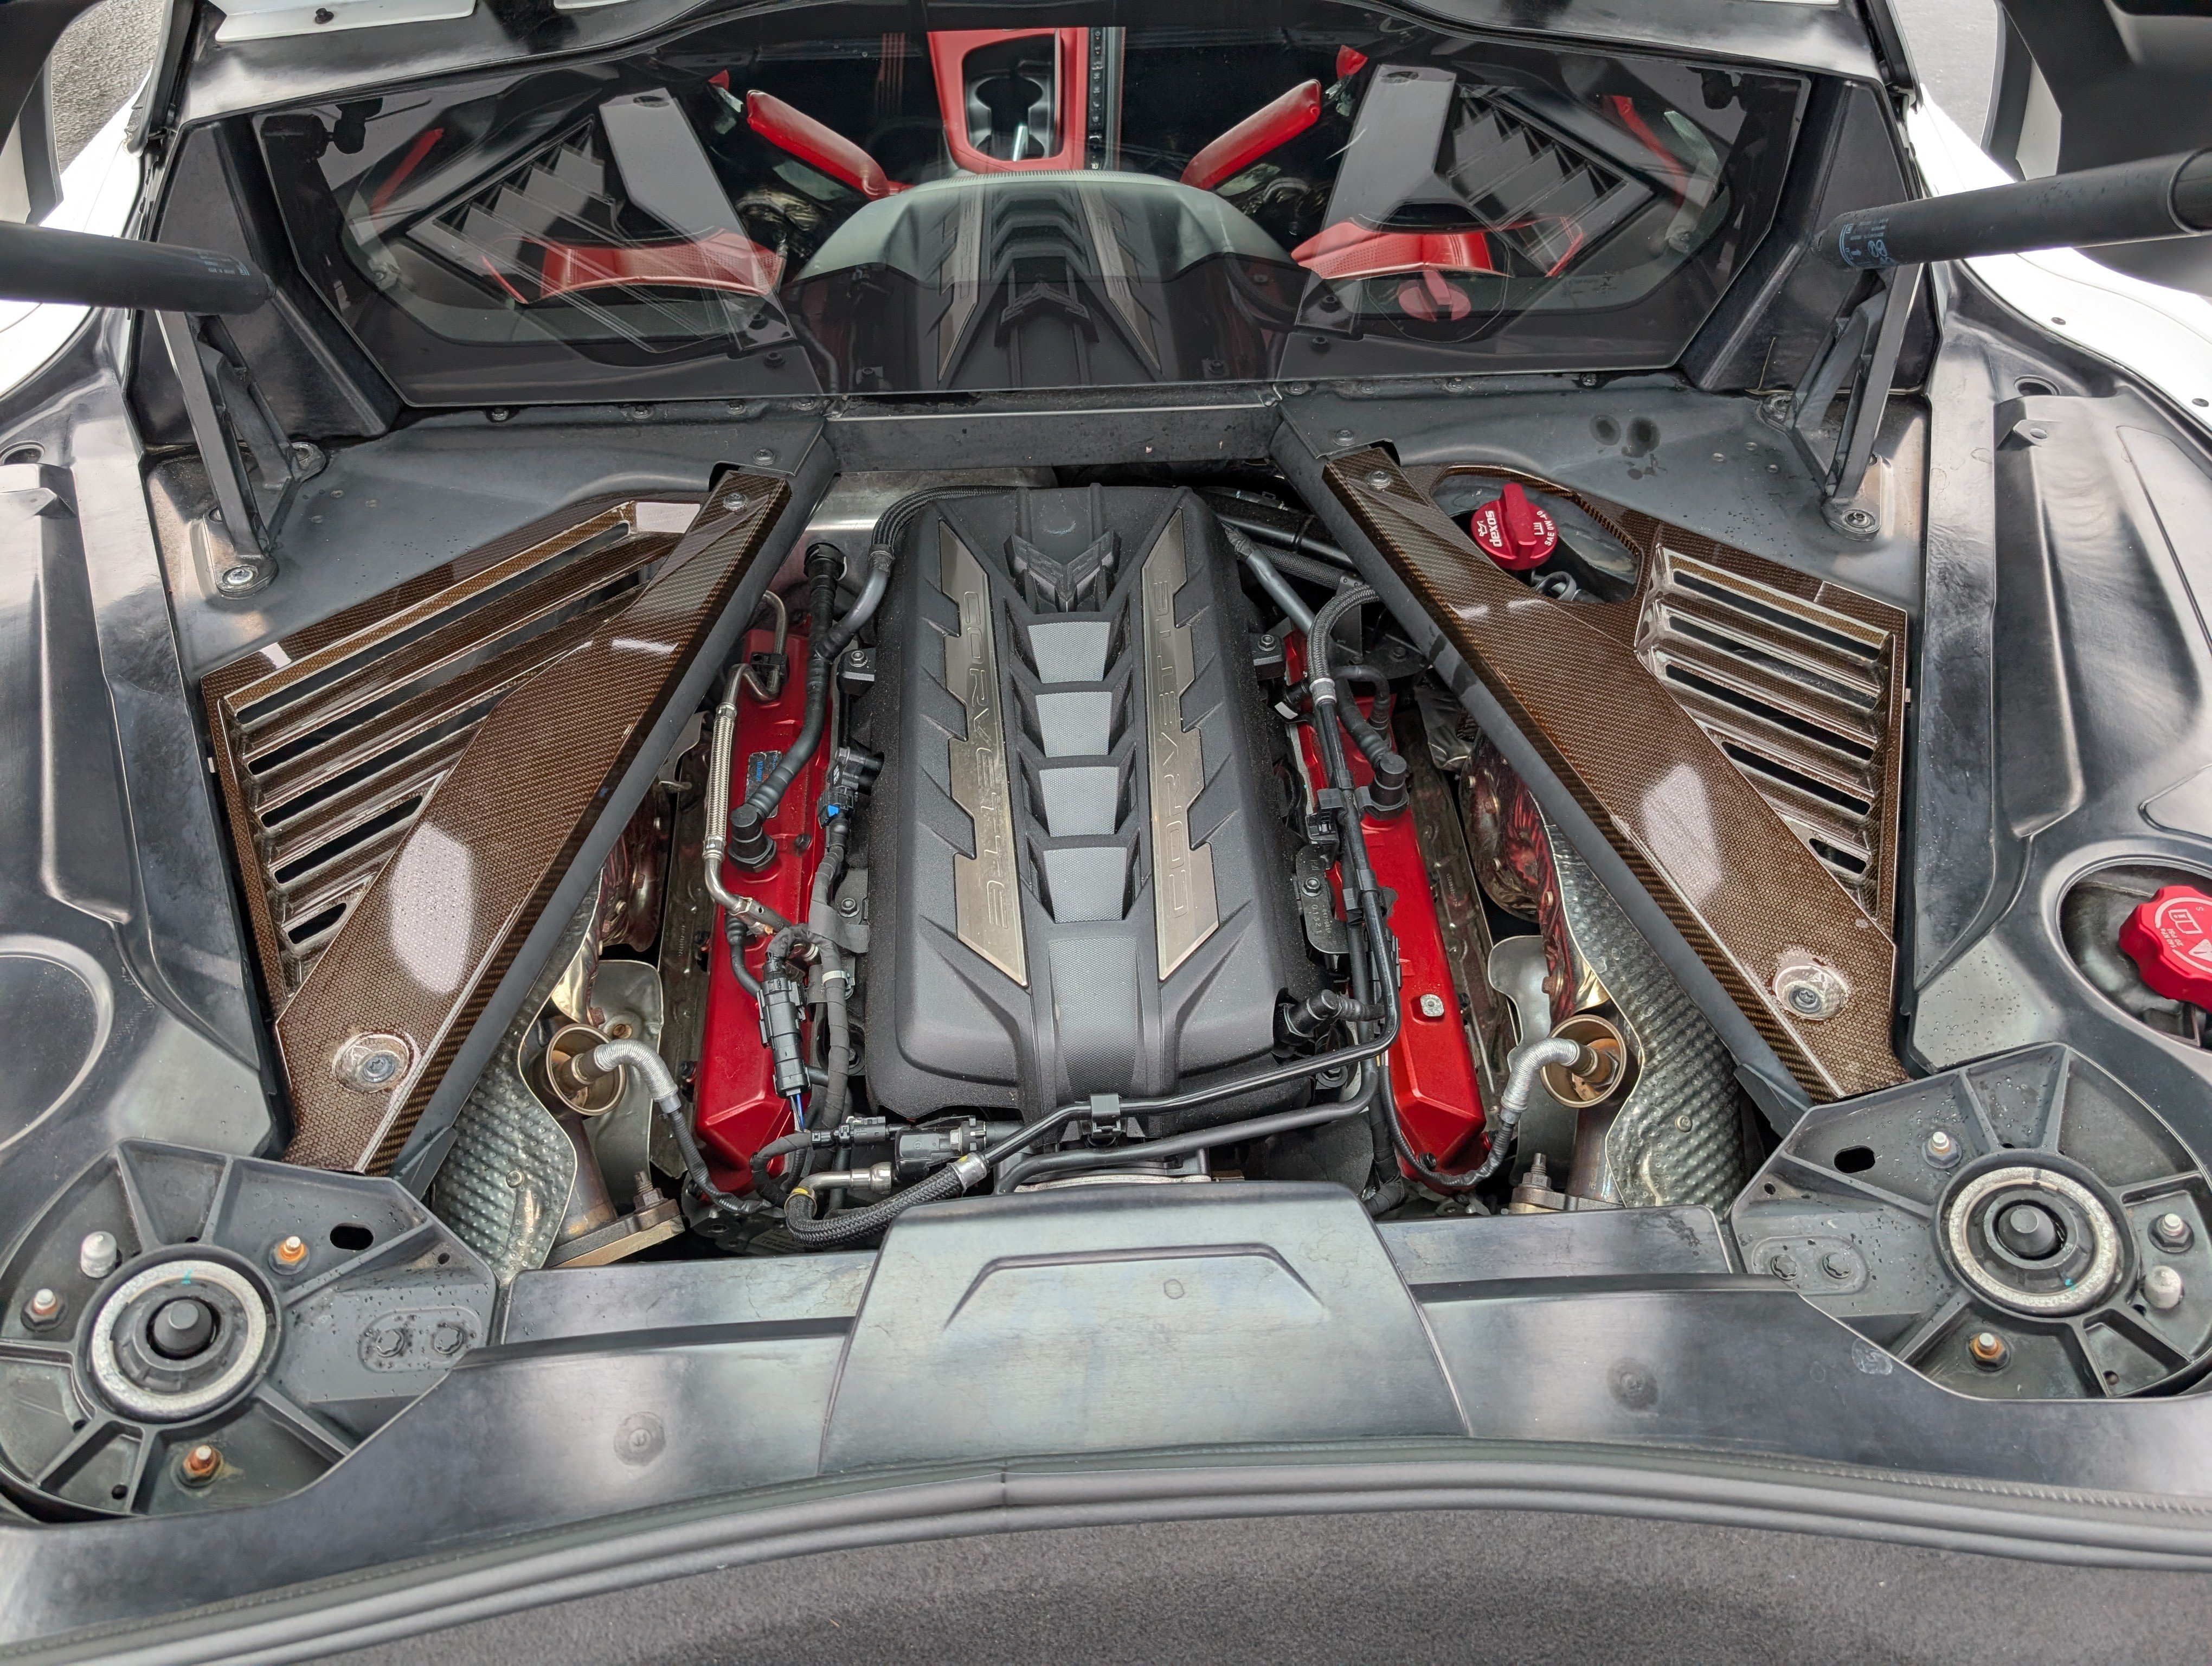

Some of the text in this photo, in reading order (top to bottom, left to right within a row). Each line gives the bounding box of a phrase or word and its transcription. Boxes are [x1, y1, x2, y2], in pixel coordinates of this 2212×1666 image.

[1485, 510, 1502, 547] dexos
[1536, 510, 1555, 546] SAE 0W-40
[963, 591, 1009, 930] CORVETTE
[1154, 580, 1188, 919] CORVETTE
